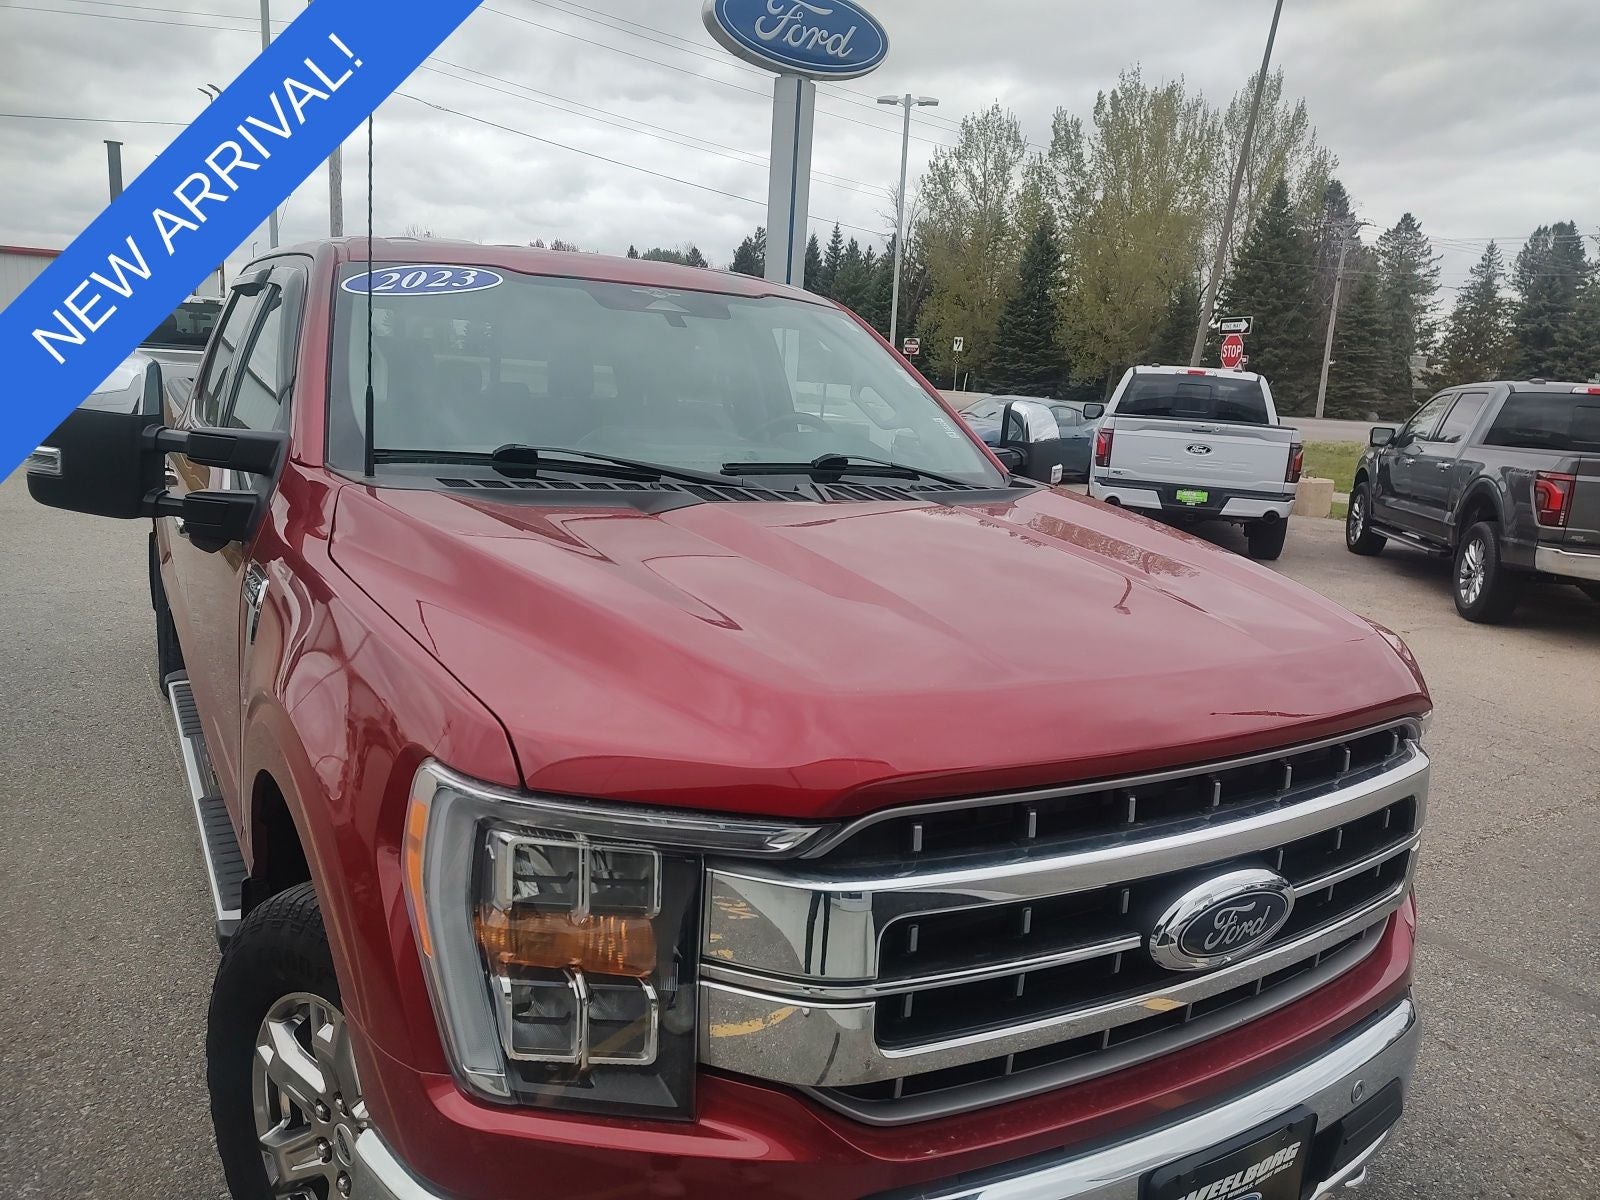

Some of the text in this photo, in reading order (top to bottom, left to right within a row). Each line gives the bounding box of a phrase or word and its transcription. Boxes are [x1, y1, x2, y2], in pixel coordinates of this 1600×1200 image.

[754, 0, 857, 58] Ford
[372, 270, 478, 291] 2023
[1222, 344, 1242, 358] STOP
[1204, 901, 1271, 950] Ford
